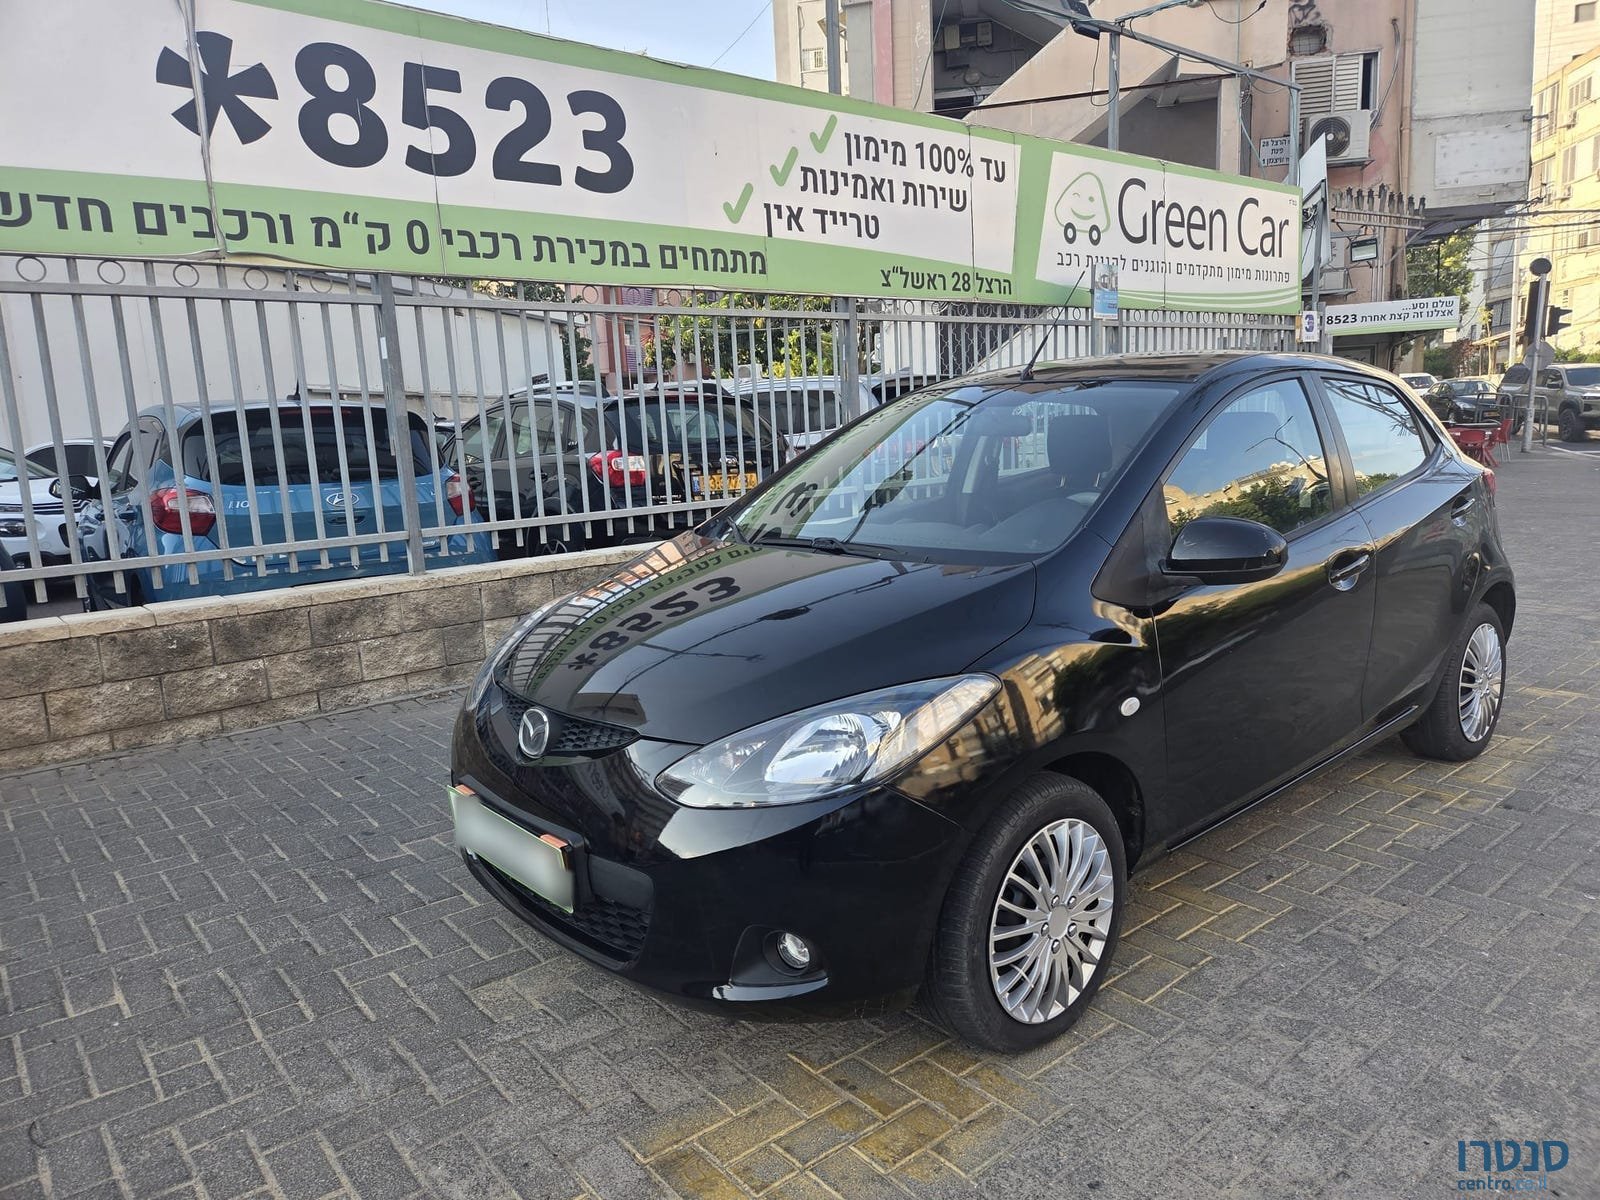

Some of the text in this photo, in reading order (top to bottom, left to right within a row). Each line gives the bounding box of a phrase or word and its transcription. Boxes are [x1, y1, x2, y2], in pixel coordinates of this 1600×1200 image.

[844, 132, 1006, 183] עד 100% מימון
[800, 166, 967, 212] שירות ואמינות
[133, 201, 294, 245] ורכבים
[763, 202, 880, 239] טרייד אין
[1117, 178, 1289, 258] Green Car
[406, 219, 430, 255] 0
[441, 228, 522, 261] רכבי
[533, 234, 651, 269] במכירת
[659, 244, 767, 275] מתמחים
[1057, 252, 1080, 267] רכב
[1132, 258, 1172, 274] והוגנים
[1176, 262, 1223, 280] מתקדמים
[1227, 266, 1252, 282] מימון
[951, 270, 971, 292] 28
[975, 272, 1012, 295] הרצל
[1255, 269, 1290, 283] פתרונות
[1326, 313, 1358, 325] 8523
